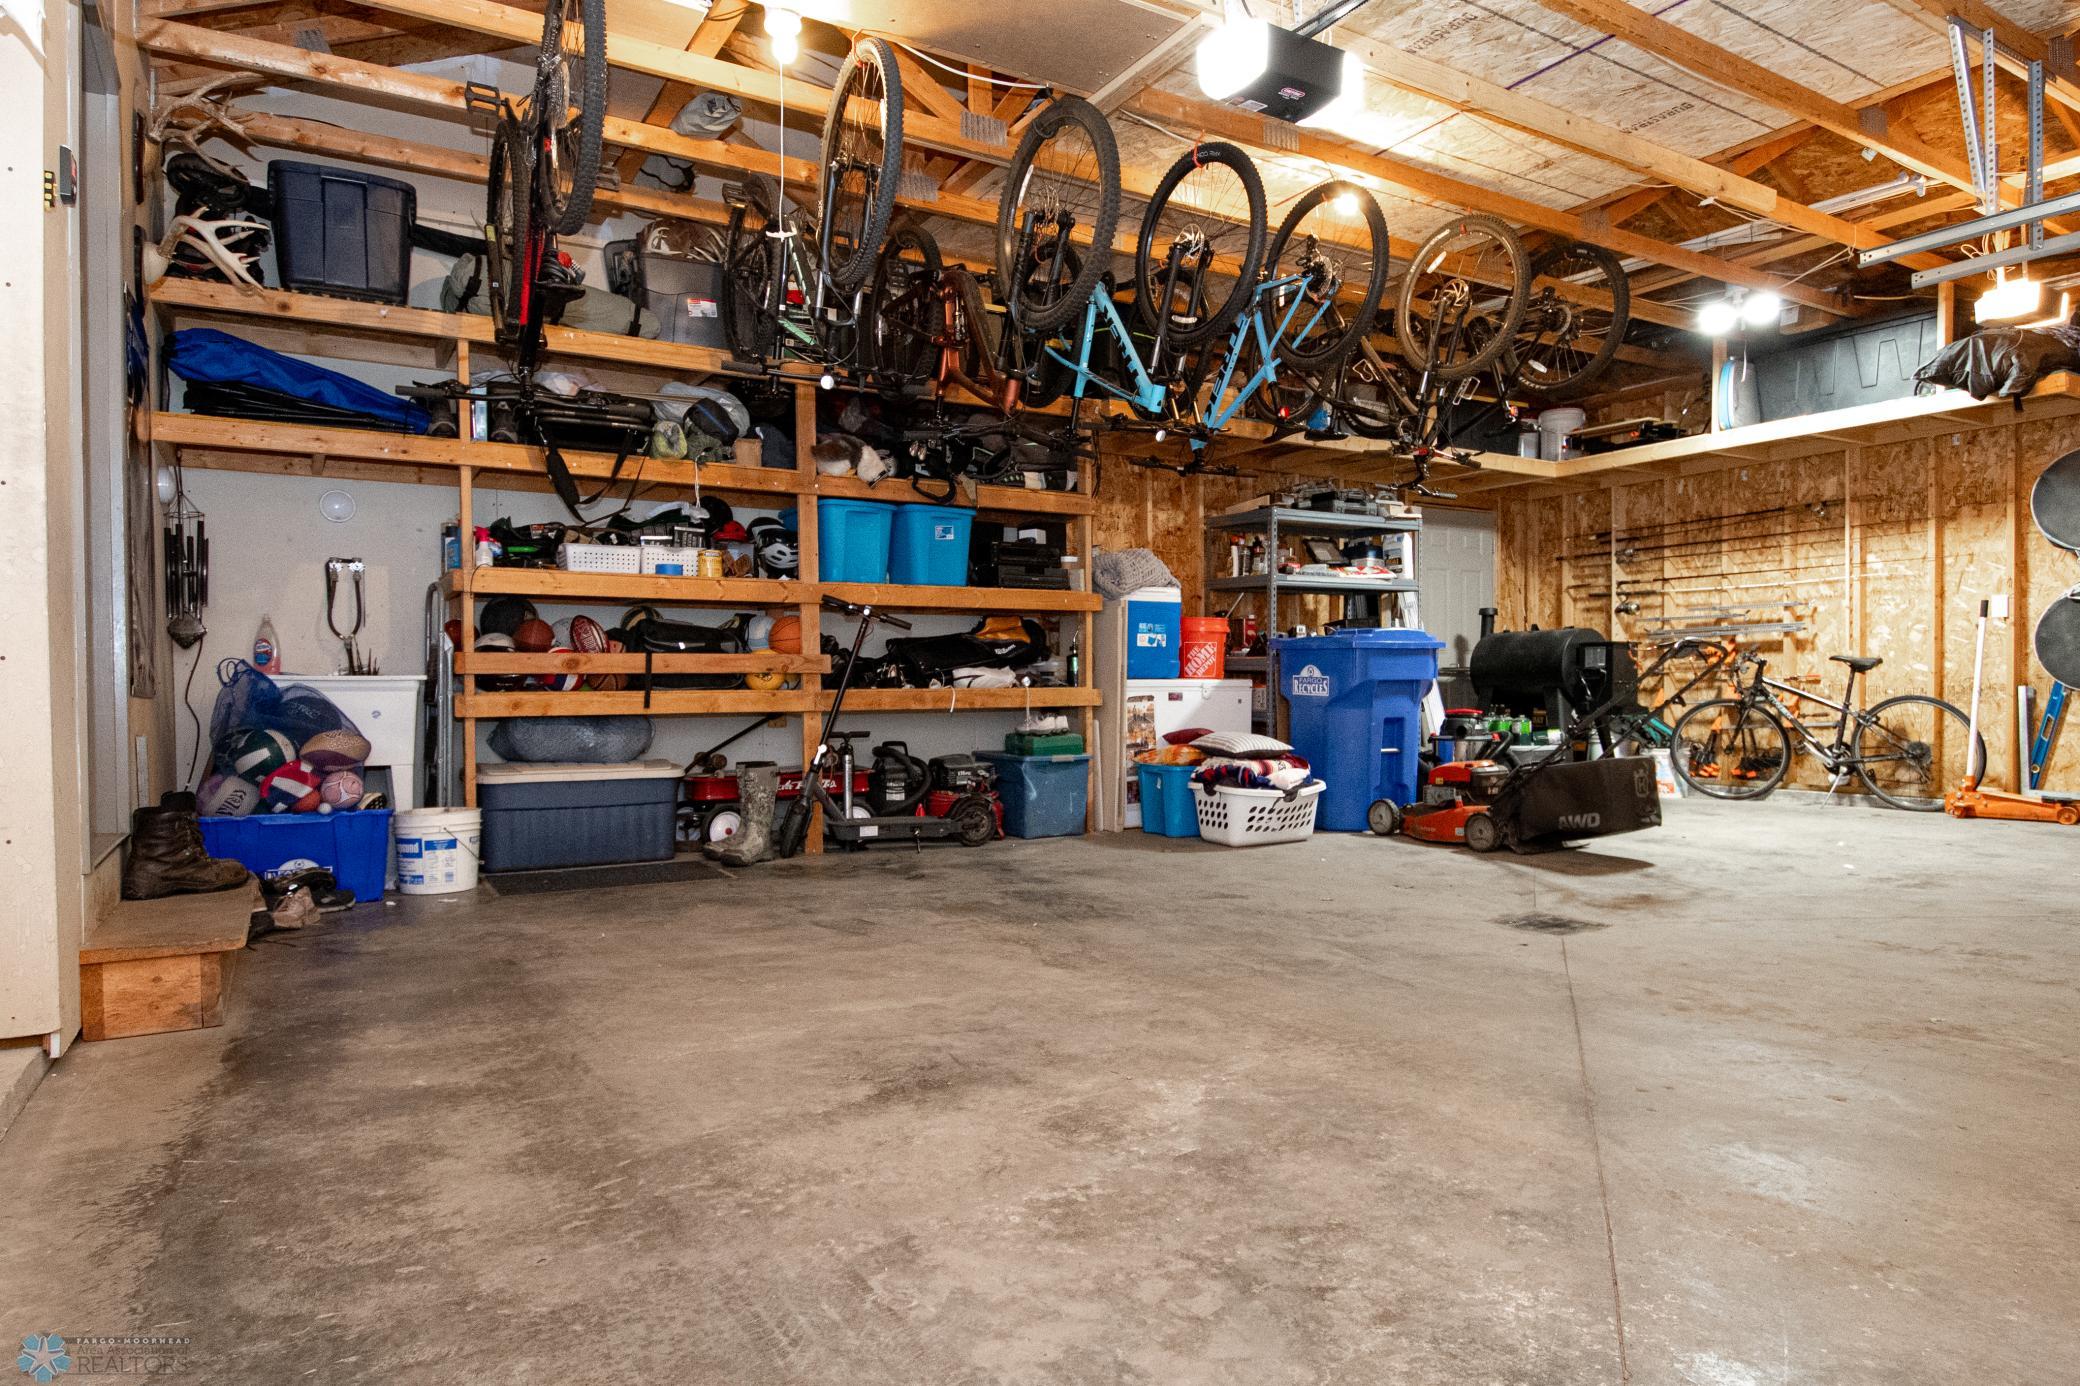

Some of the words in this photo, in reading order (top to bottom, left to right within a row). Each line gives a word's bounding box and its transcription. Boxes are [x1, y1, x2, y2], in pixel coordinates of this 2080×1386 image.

[1185, 642, 1216, 676] HOME
[1187, 645, 1200, 660] THE
[1196, 654, 1216, 676] DEPOT
[1294, 679, 1328, 694] RECYCLES
[1558, 812, 1601, 829] AWD
